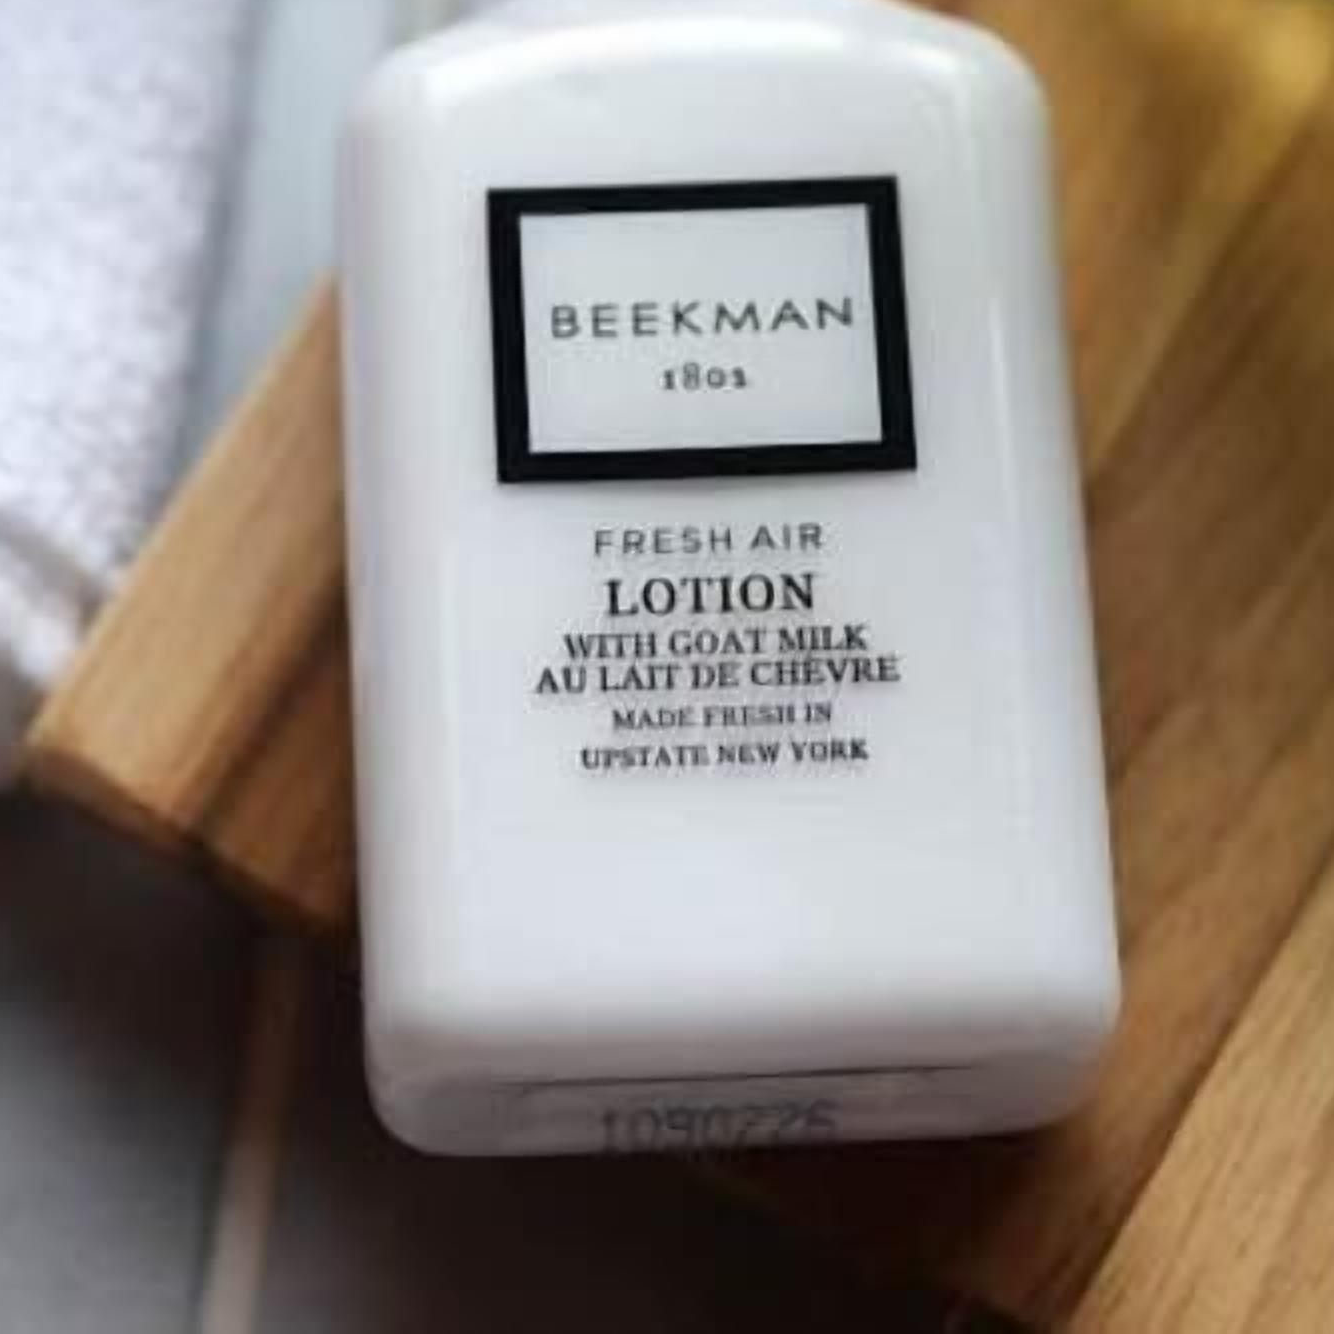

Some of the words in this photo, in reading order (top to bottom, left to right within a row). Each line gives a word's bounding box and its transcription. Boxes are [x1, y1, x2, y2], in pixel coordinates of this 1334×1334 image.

[550, 296, 854, 340] BEEKMAN
[662, 362, 749, 392] 1801
[593, 526, 733, 557] FRESH
[750, 522, 825, 552] AIR
[604, 571, 819, 617] LOTION
[563, 631, 657, 661] WITH
[667, 627, 766, 658] GOAT
[777, 623, 869, 652] MILK
[535, 666, 588, 695] AU
[599, 664, 681, 693] LAIT
[690, 662, 740, 689] DE
[611, 707, 694, 731] MADE
[703, 704, 795, 729] FRESH
[803, 701, 833, 724] IN
[580, 745, 707, 771] UPSTATE
[717, 741, 780, 766] NEW
[790, 737, 870, 763] YORK
